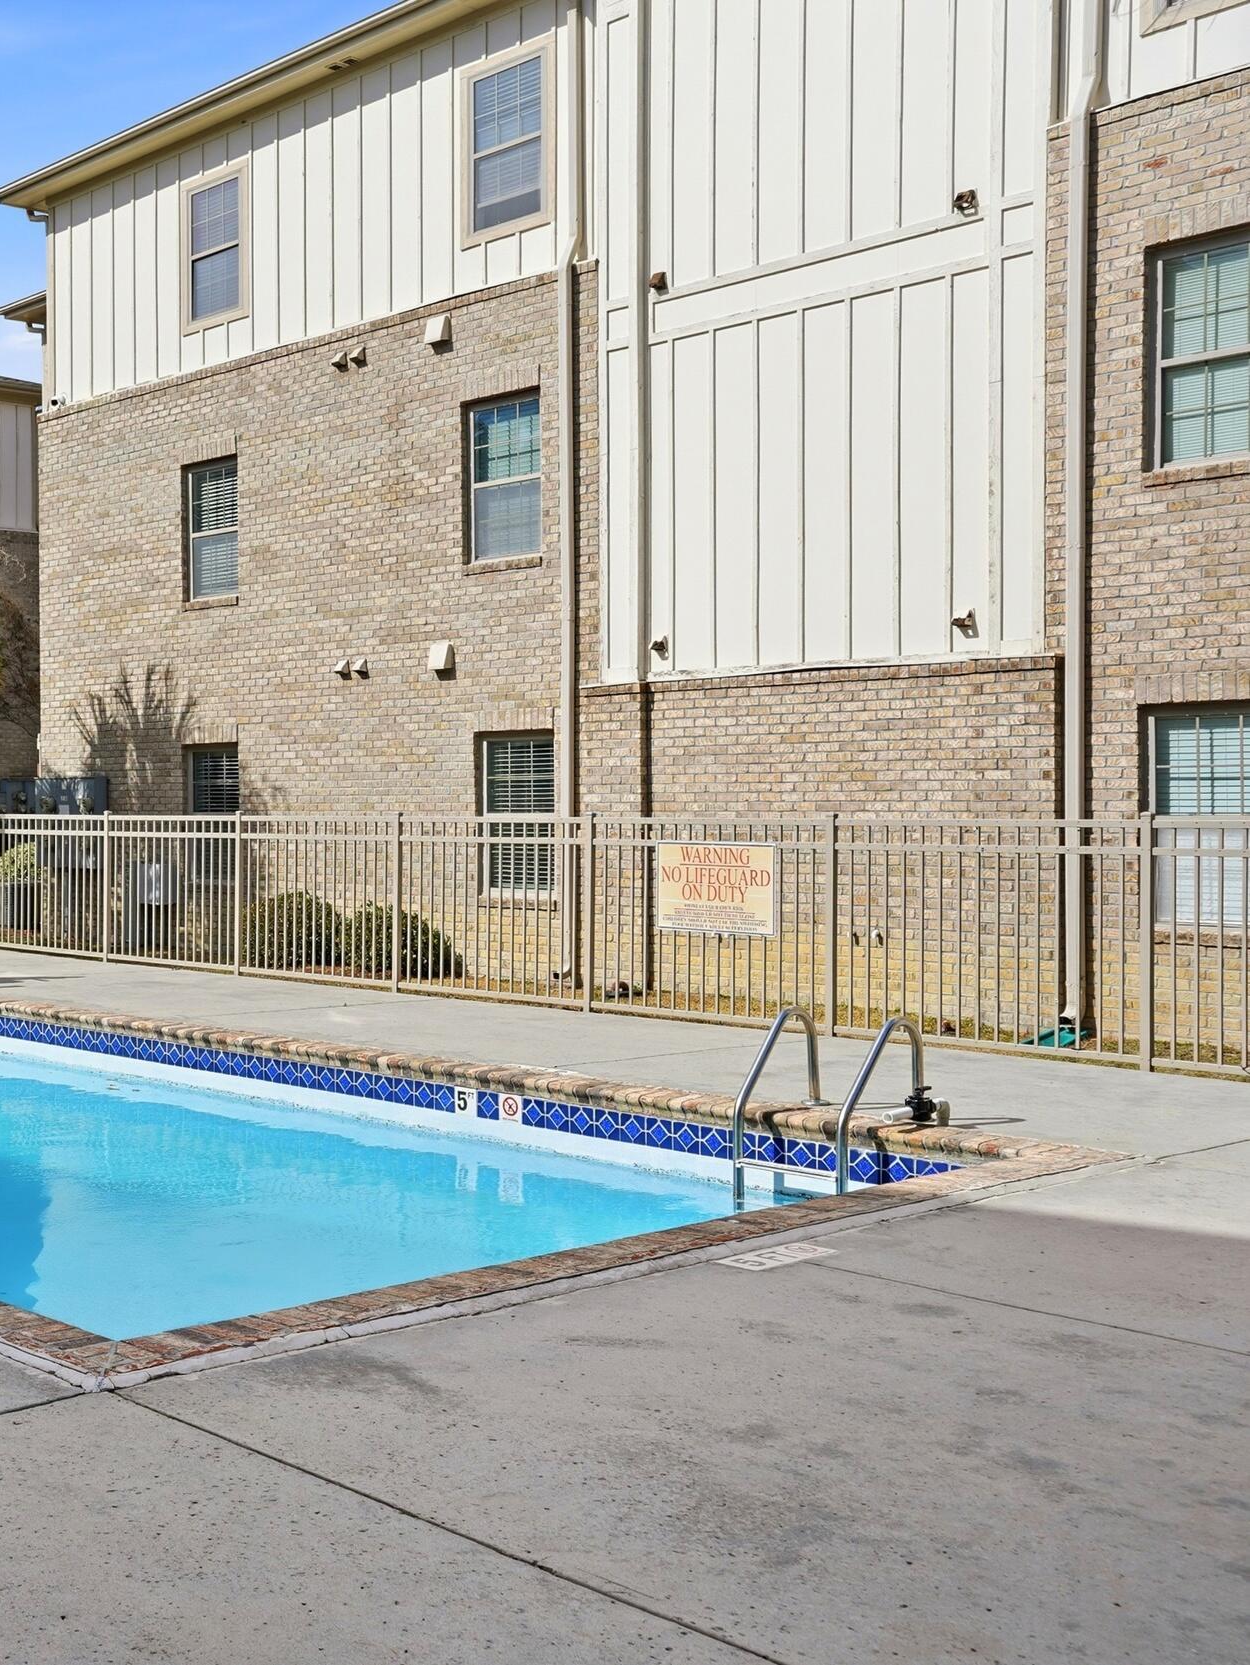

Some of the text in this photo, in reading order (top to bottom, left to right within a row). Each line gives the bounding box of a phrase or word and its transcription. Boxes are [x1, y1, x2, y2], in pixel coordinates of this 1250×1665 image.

[680, 846, 750, 865] WARNING
[661, 866, 771, 887] NO LIFEGUARD
[682, 883, 749, 903] ON DUTY
[457, 1090, 468, 1111] 5
